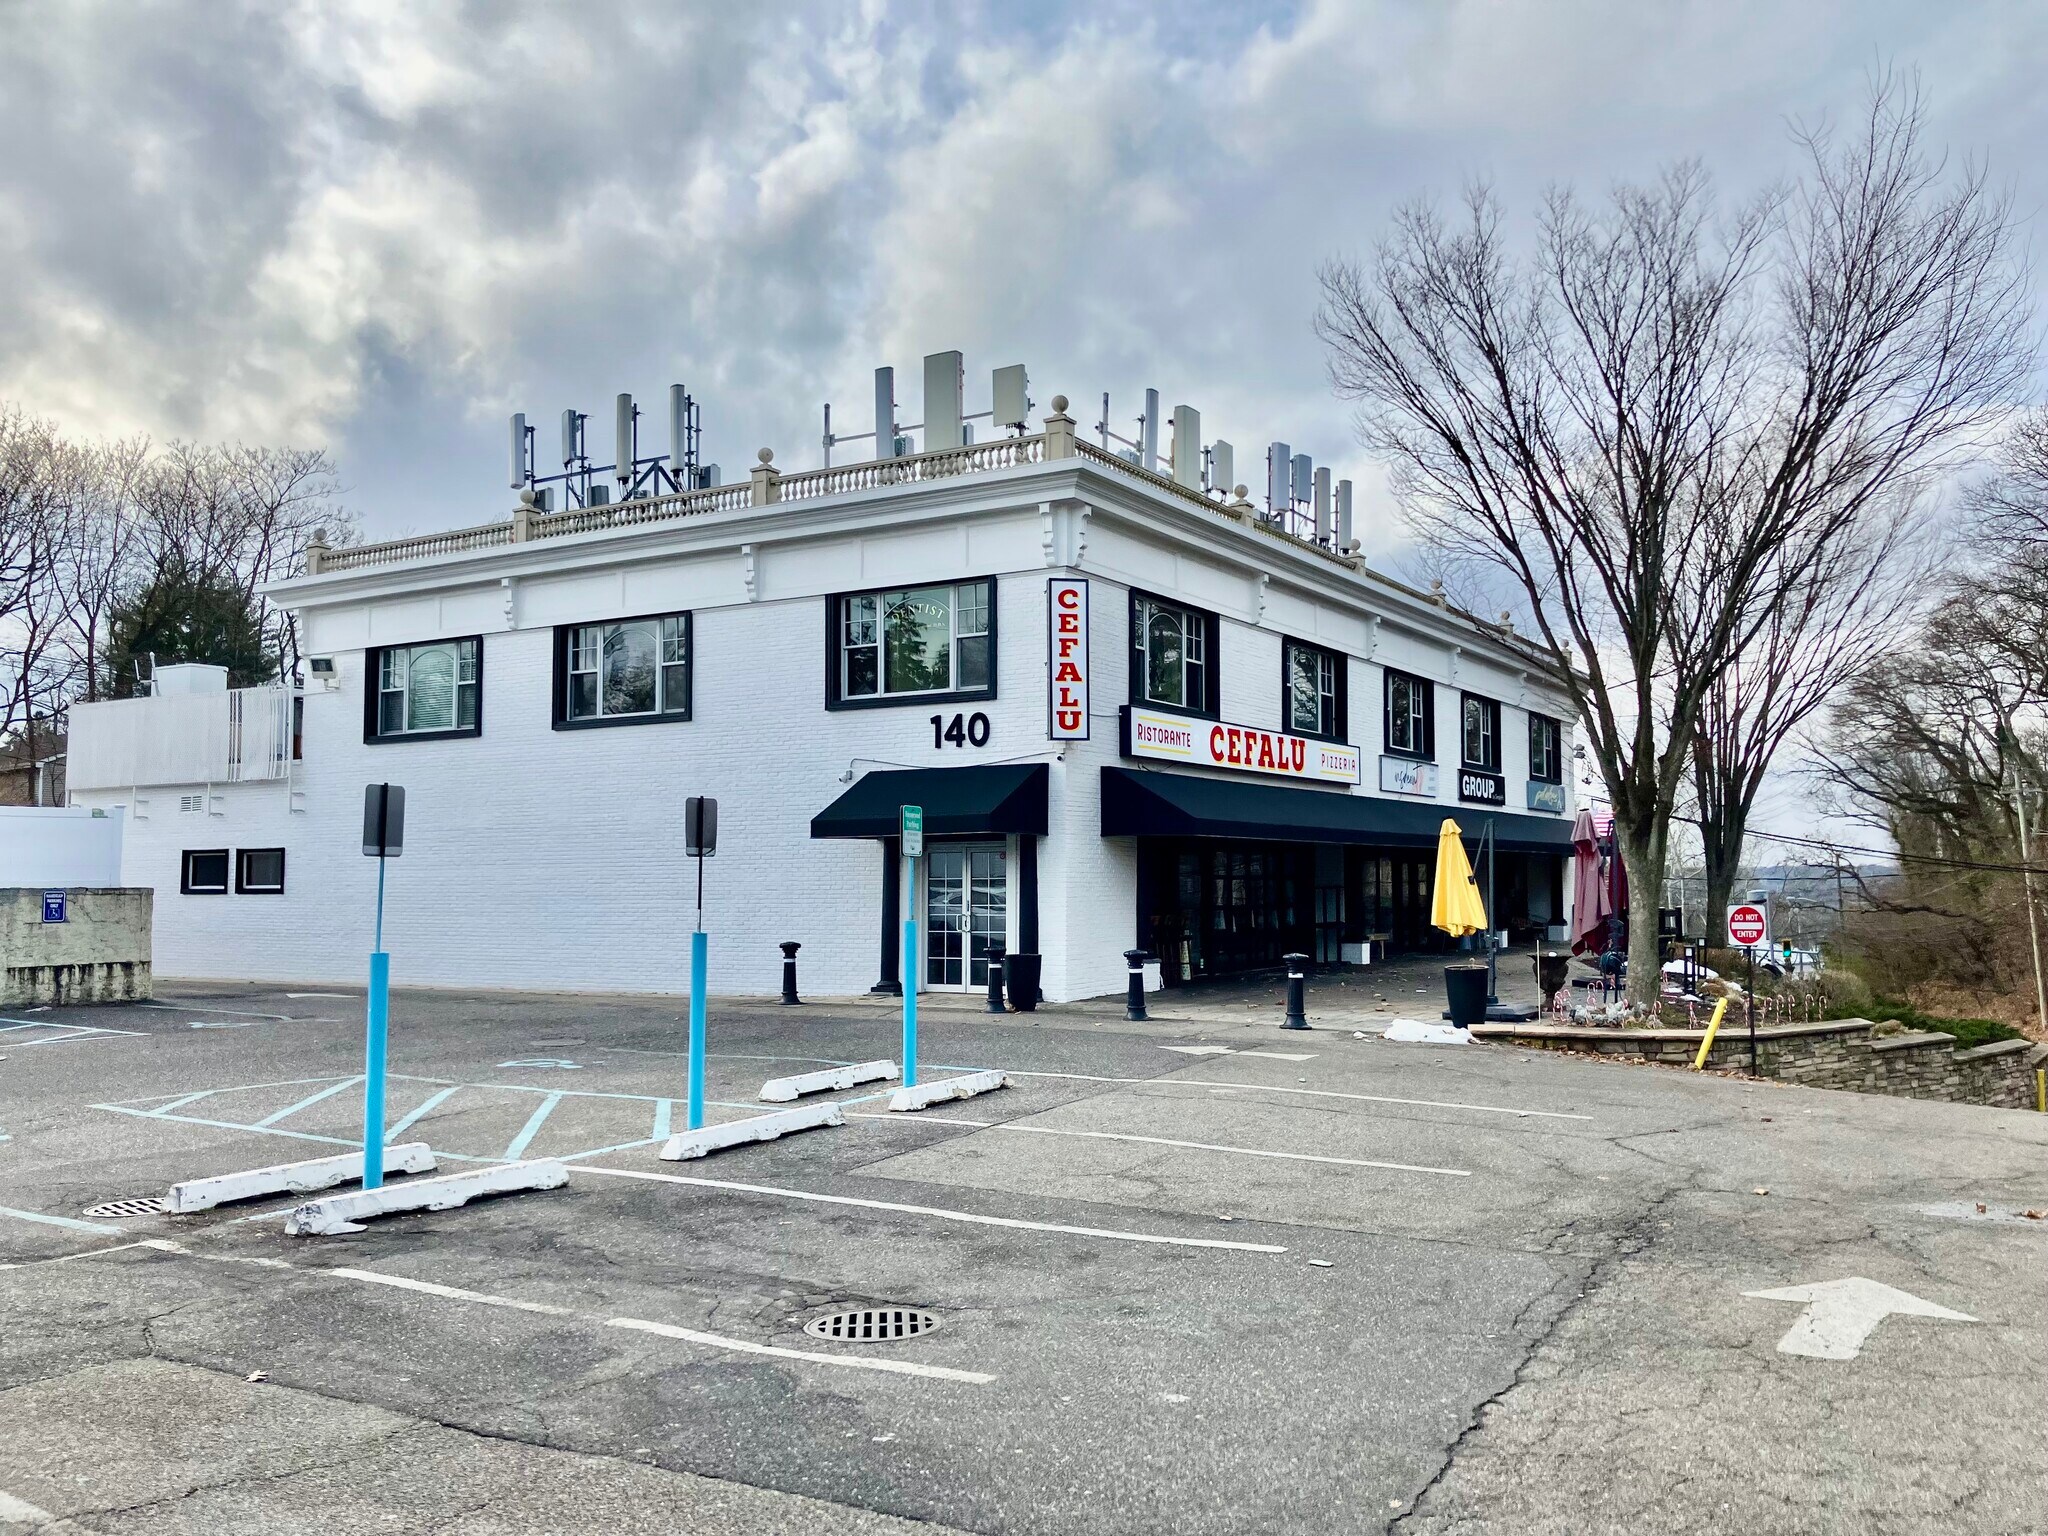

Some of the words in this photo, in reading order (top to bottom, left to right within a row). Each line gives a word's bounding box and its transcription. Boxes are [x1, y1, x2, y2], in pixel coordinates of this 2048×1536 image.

[891, 603, 945, 624] DENTIST
[1055, 588, 1083, 732] CEFALU
[929, 711, 991, 749] 140
[1209, 725, 1306, 774] CEFALU
[1321, 753, 1356, 771] PIZZERIA
[1462, 774, 1495, 799] GROUP
[1734, 913, 1744, 921] DO
[1745, 913, 1759, 921] NOT
[1737, 930, 1758, 938] ENTER
